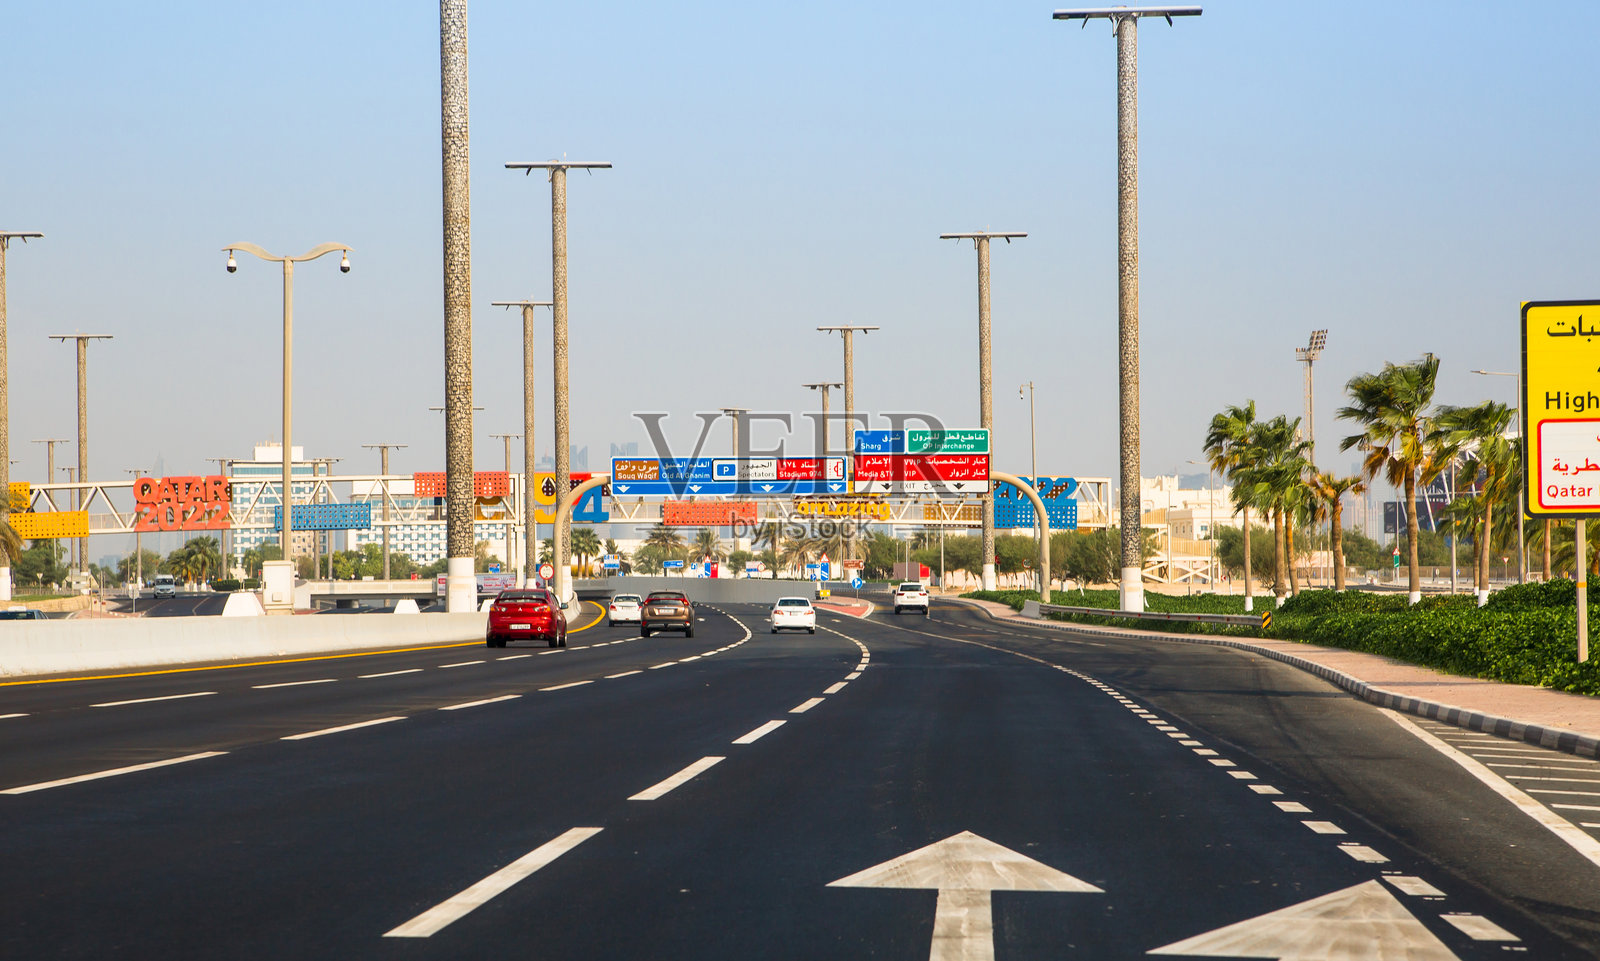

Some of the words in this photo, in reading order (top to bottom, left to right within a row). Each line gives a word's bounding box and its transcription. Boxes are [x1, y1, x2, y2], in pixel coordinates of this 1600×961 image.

[1545, 391, 1600, 412] High
[934, 442, 975, 450] Interchange
[972, 457, 987, 466] كبار
[723, 466, 730, 475] P
[779, 470, 808, 478] Stadium
[809, 470, 822, 478] 974
[972, 468, 987, 478] كبار
[617, 472, 636, 480] Souq
[637, 472, 657, 480] Waqif
[133, 475, 231, 504] QATAR
[1547, 484, 1593, 499] Qatar
[134, 500, 231, 532] 2022
